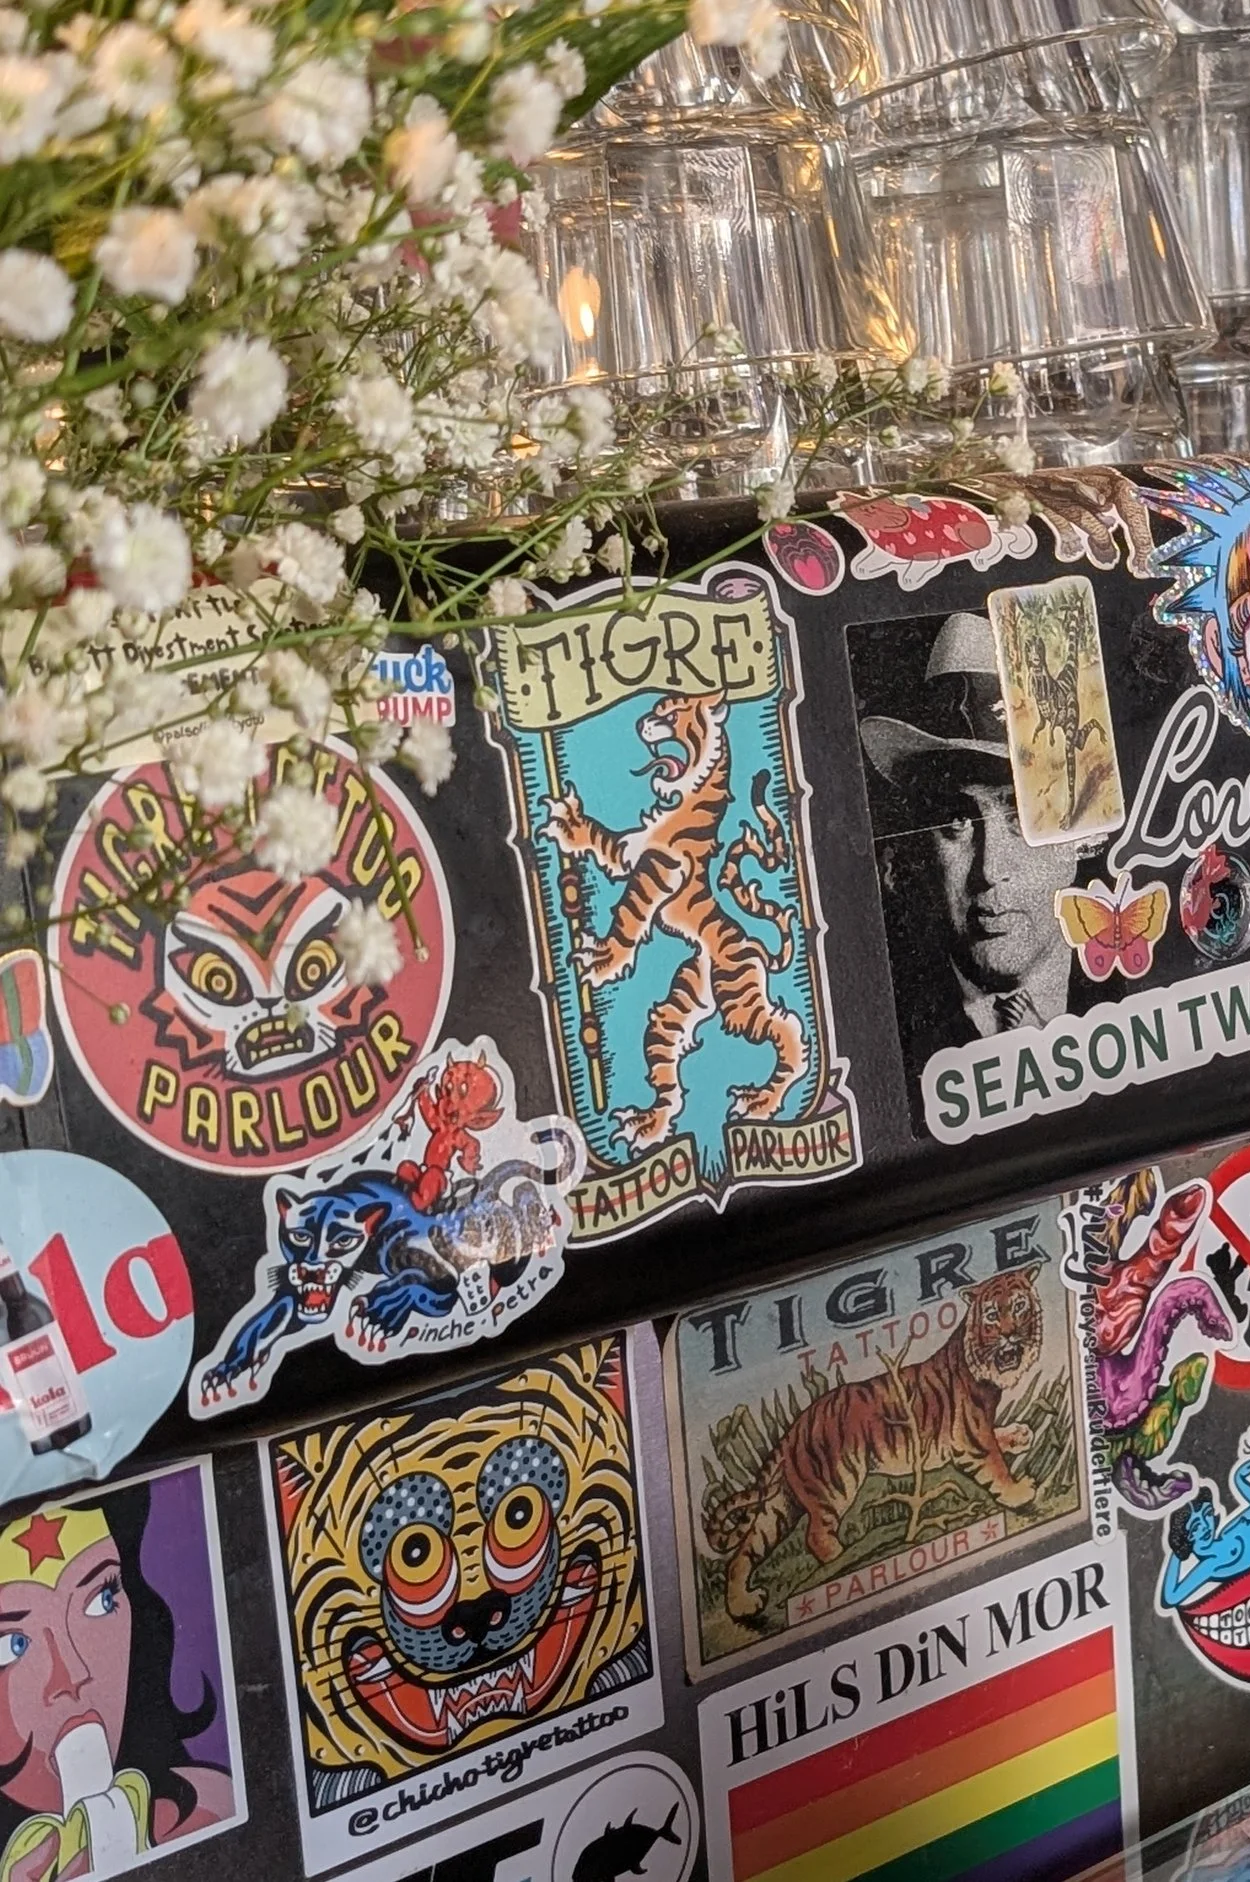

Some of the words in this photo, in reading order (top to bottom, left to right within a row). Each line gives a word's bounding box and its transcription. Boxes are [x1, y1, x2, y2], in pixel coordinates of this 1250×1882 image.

[376, 696, 453, 726] RUMP
[519, 611, 757, 722] TIGRE
[140, 1016, 416, 1151] PARLOUR
[935, 1006, 1170, 1129] SEASON
[568, 1146, 692, 1230] TATTOO
[731, 1119, 850, 1173] PARLOUR
[400, 1318, 475, 1348] pinche
[688, 1213, 1051, 1376] TIGRE
[798, 1301, 960, 1376] TATTOO
[825, 1525, 973, 1610] PARLOUR
[983, 1561, 1111, 1659] MOR
